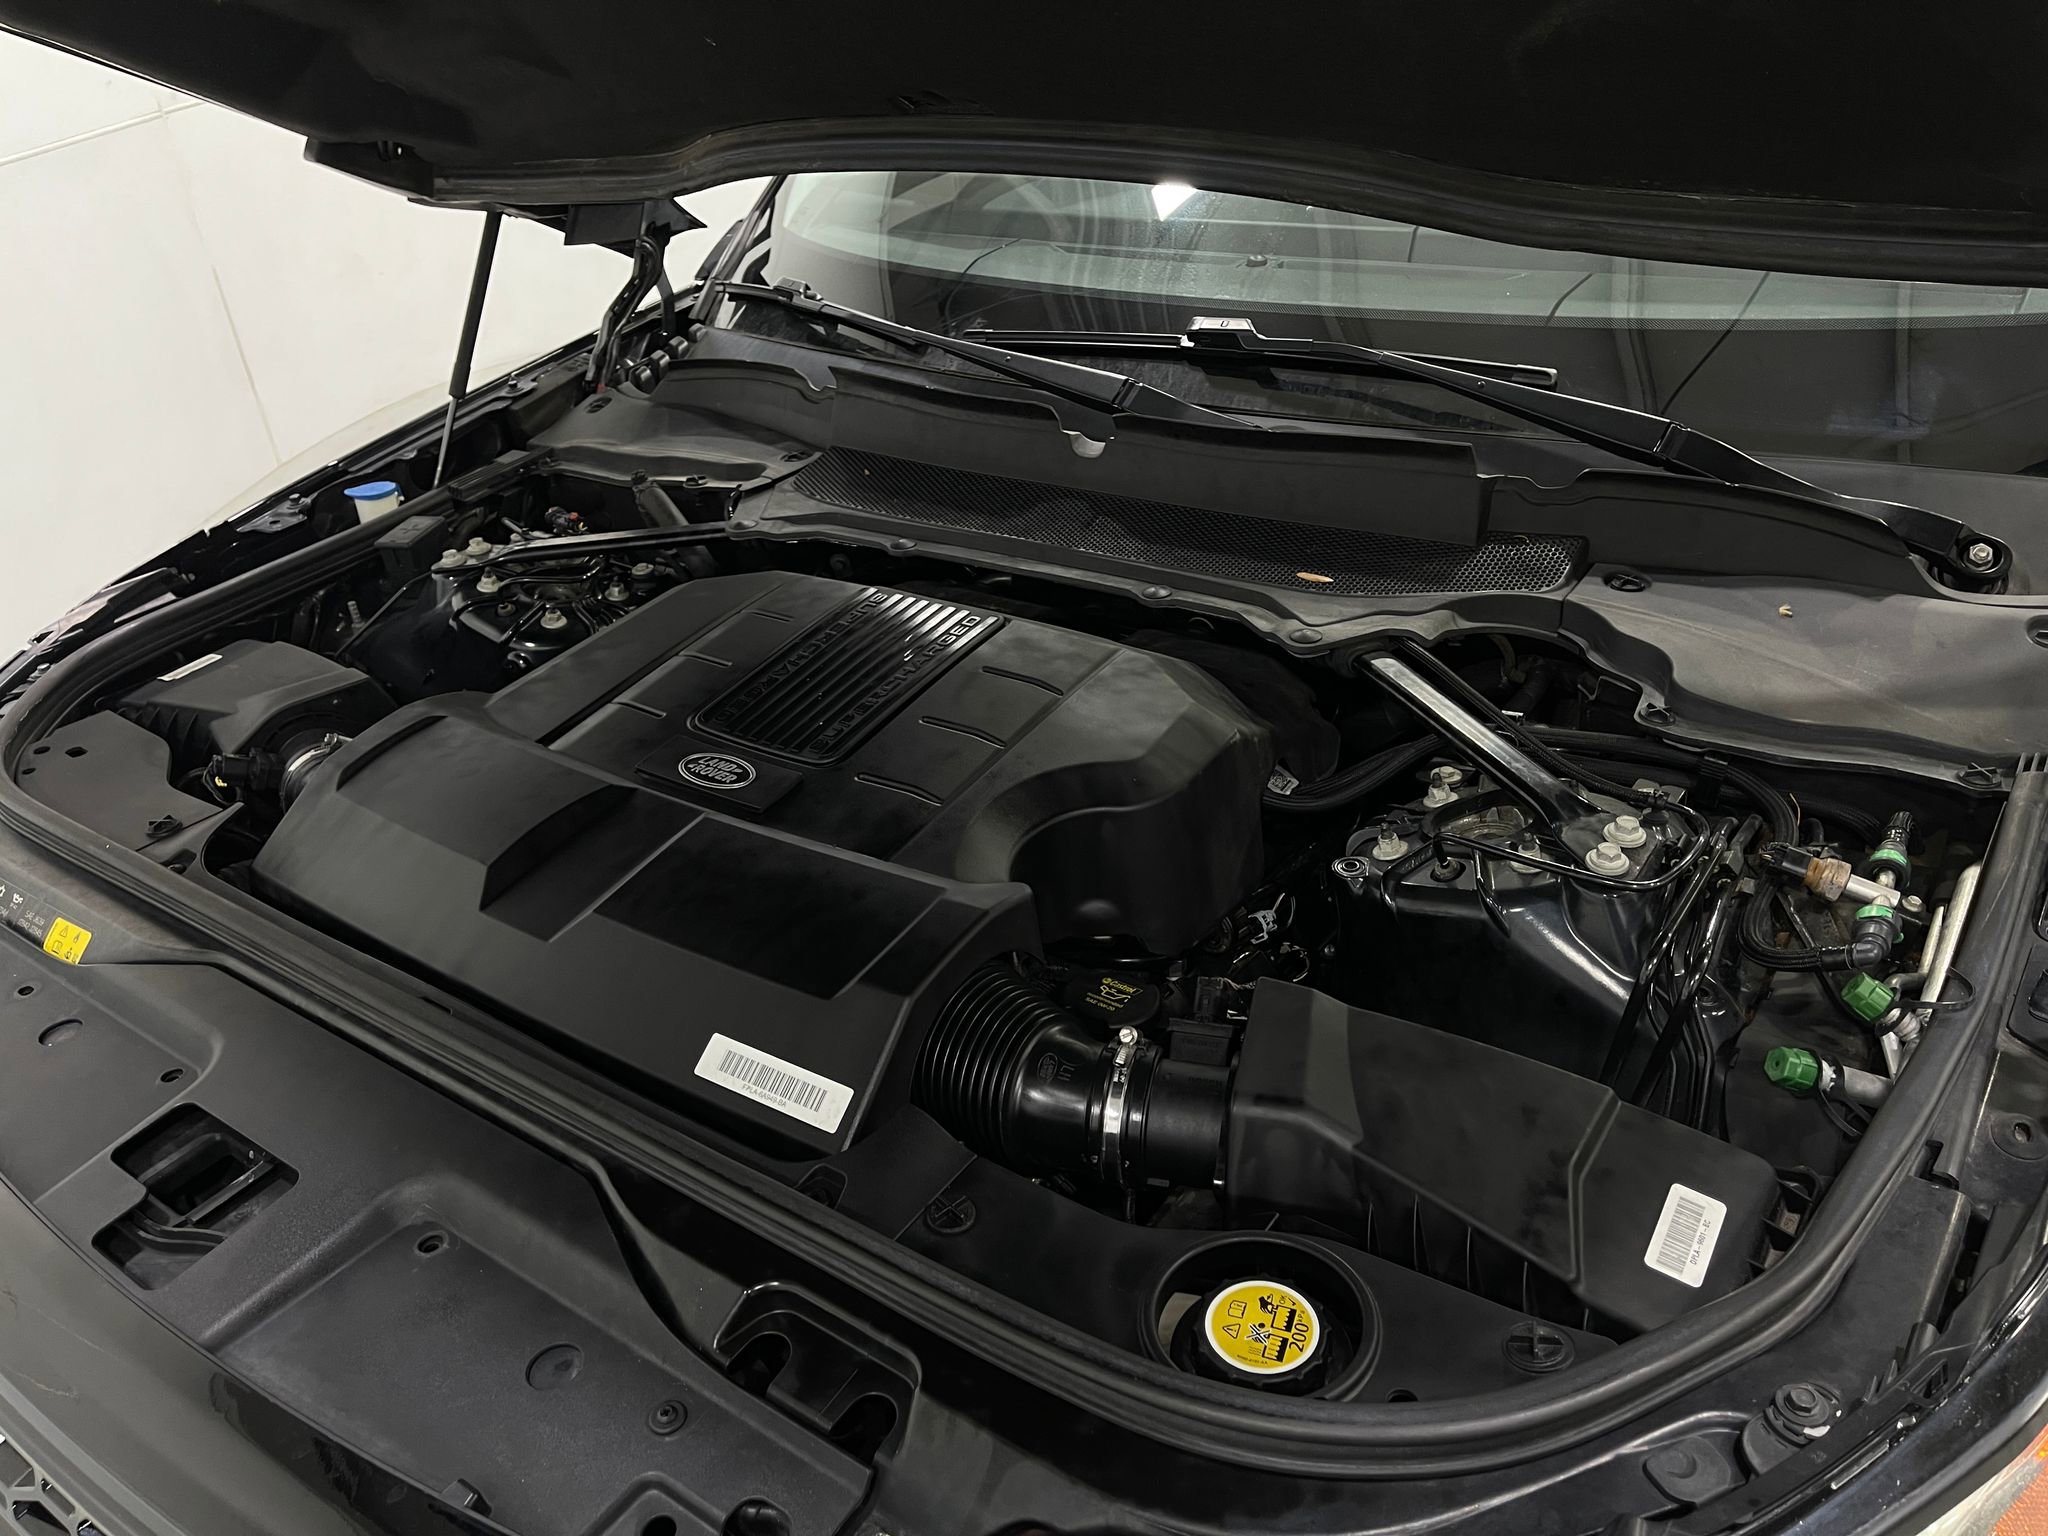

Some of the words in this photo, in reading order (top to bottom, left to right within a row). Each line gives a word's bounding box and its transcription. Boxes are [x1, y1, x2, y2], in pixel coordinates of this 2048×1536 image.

[712, 592, 889, 726] SUPERCHARGED
[807, 614, 983, 754] SUPERCHARGED
[690, 764, 738, 783] ROVER
[698, 757, 738, 771] LAND
[1109, 980, 1137, 994] Castrol
[1278, 1295, 1288, 1305] OK
[1289, 1323, 1309, 1352] 200
